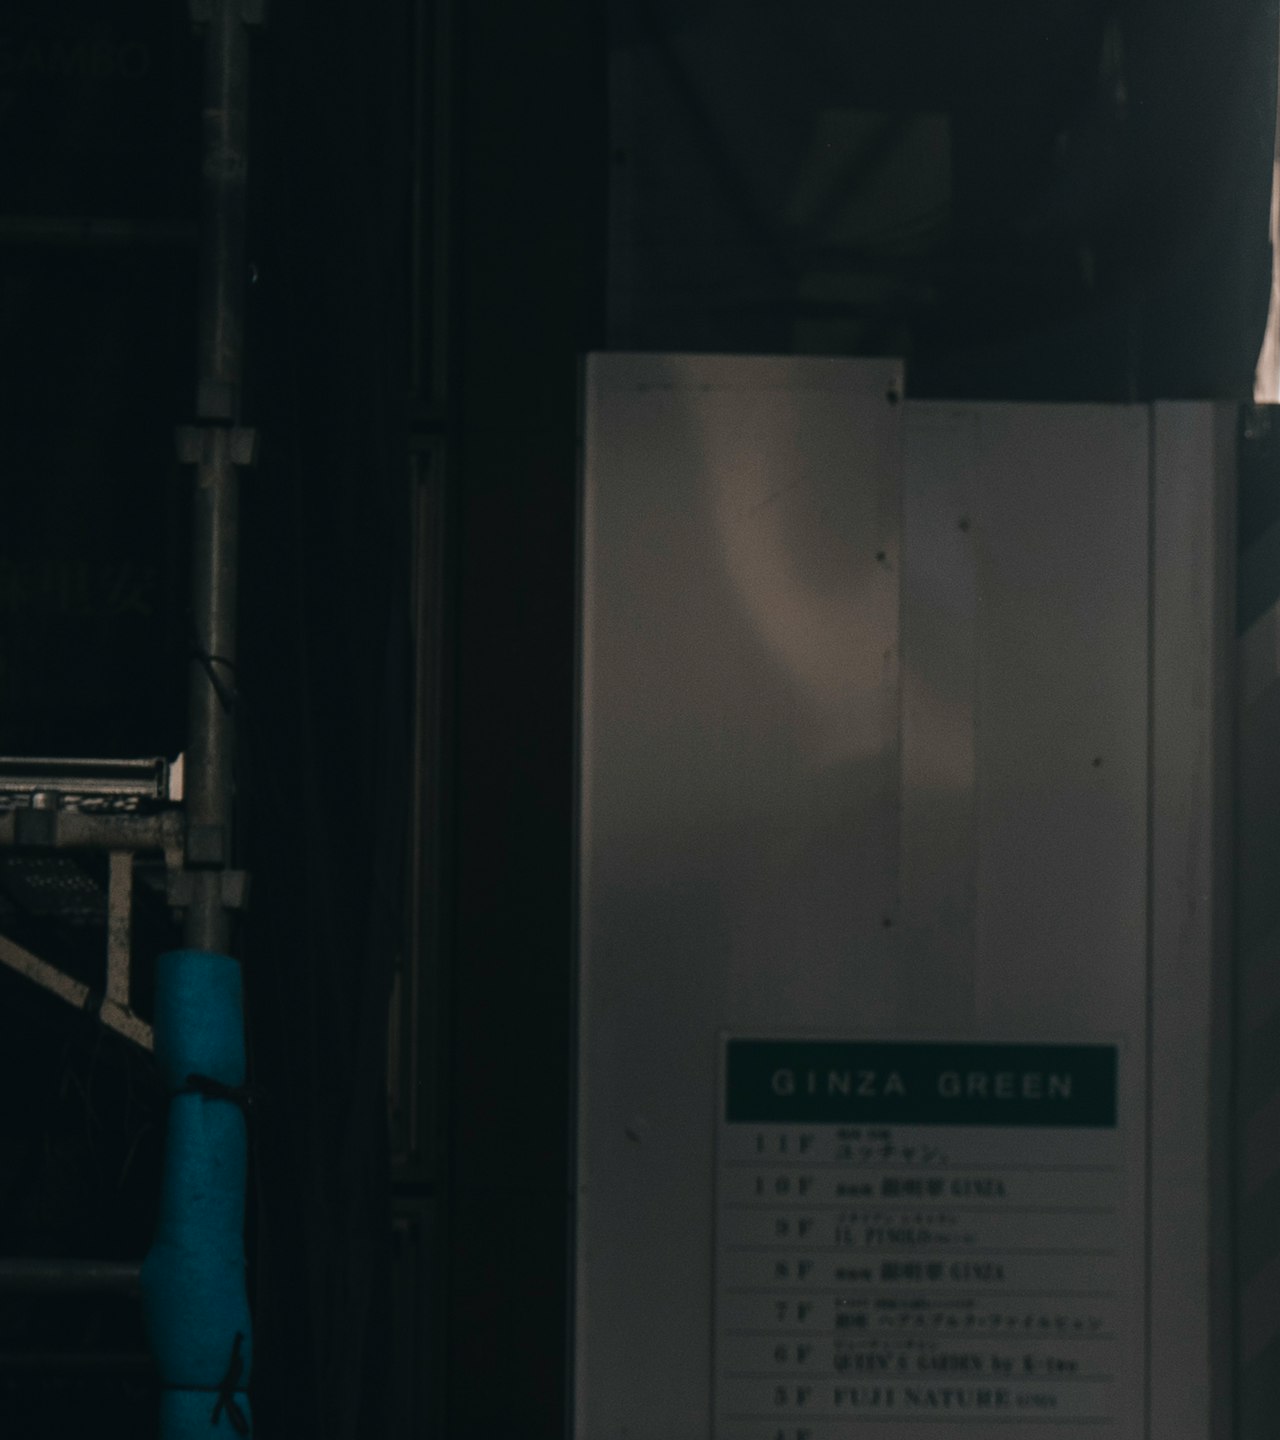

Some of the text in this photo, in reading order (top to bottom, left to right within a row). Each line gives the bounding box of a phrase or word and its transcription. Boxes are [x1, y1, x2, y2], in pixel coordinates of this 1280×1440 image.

[771, 1067, 1073, 1099] GINZA GREEN
[833, 1387, 896, 1408] FUJI
[903, 1387, 1010, 1409] NATURE
